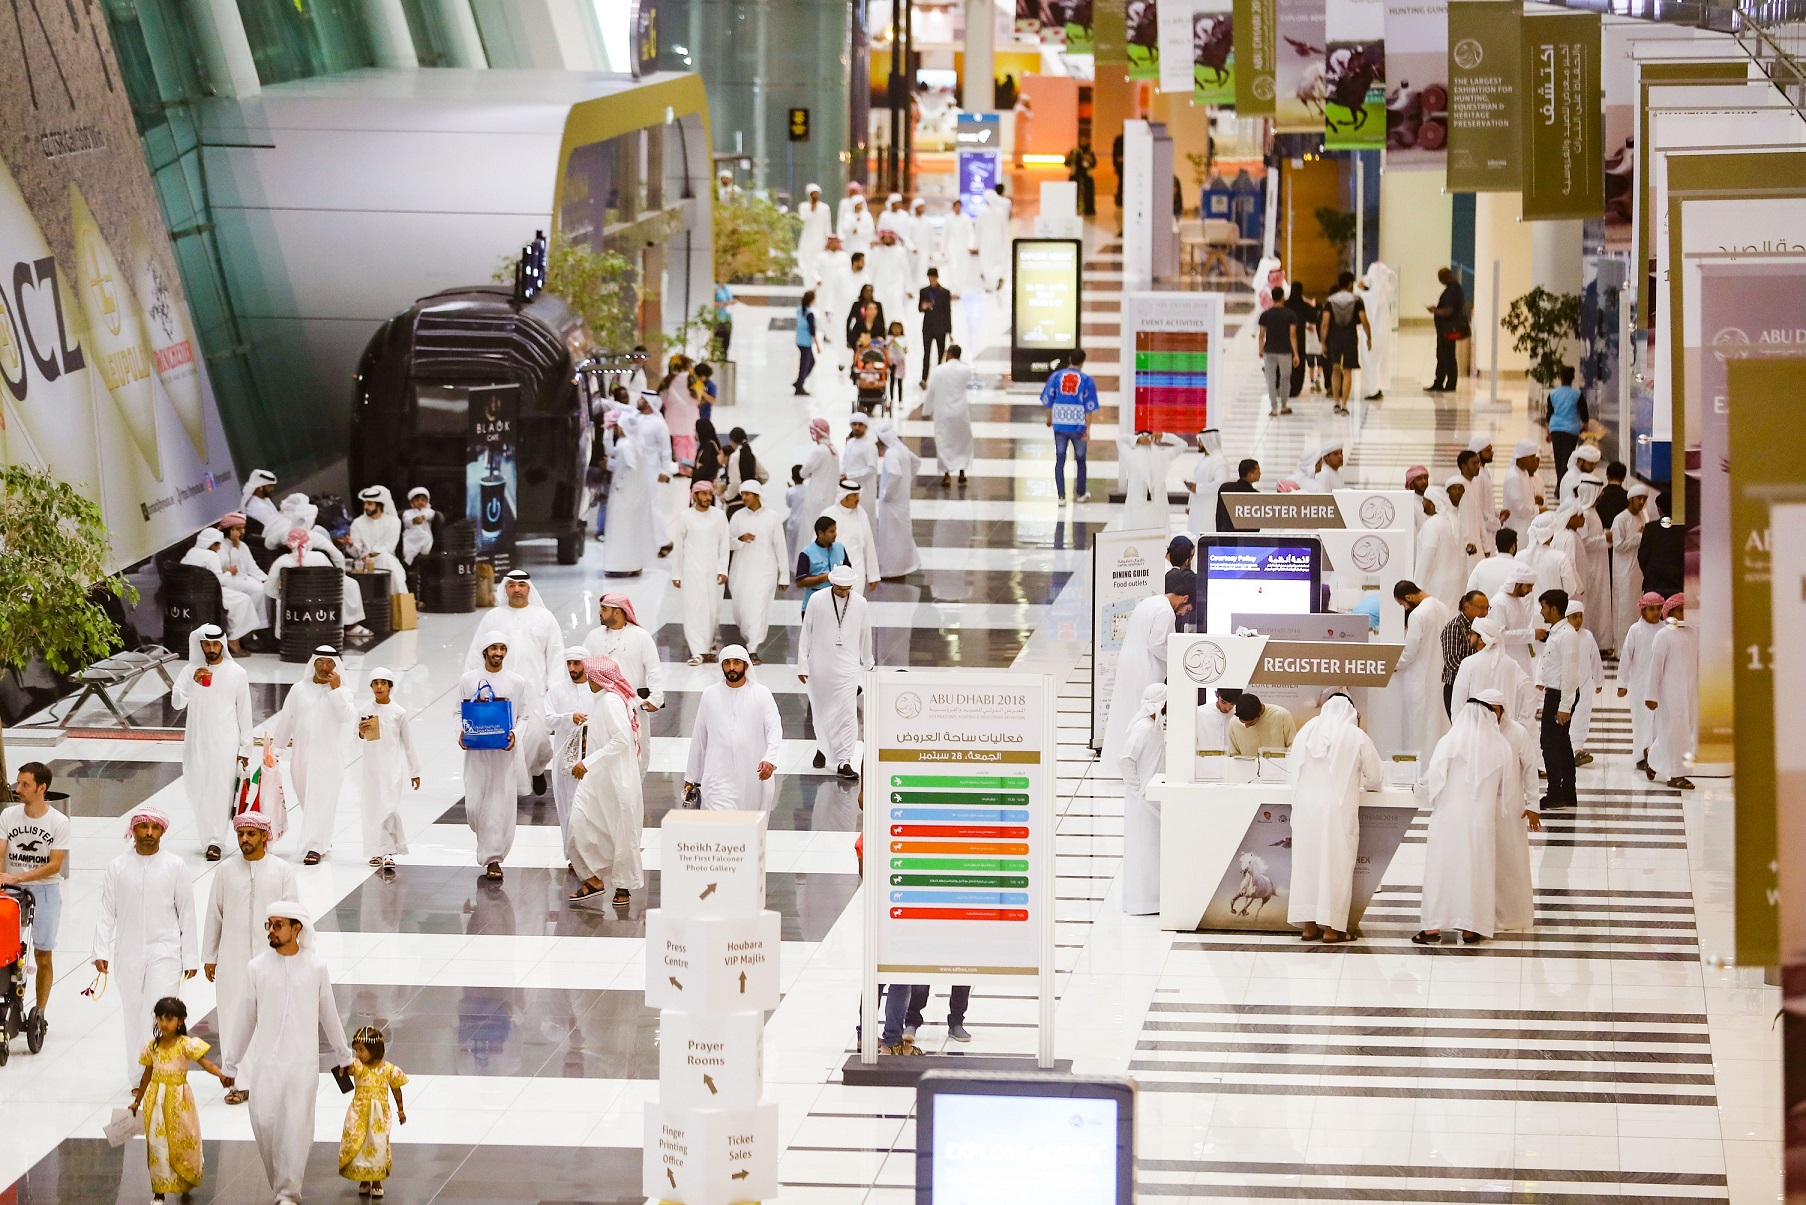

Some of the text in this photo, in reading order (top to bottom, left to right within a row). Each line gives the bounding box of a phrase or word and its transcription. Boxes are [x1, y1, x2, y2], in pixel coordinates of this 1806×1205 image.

[1454, 77, 1502, 85] THE LARGEST
[1537, 44, 1555, 126] اكتشف
[1454, 120, 1509, 128] PRESERVATION
[1759, 329, 1793, 344] ABU
[1235, 505, 1335, 518] REGISTER HERE
[1209, 554, 1257, 564] Courtesy Policy
[1112, 569, 1150, 579] DINING GUIDE
[1113, 580, 1127, 588] Food
[1263, 657, 1386, 675] REGISTER HERE
[929, 694, 1026, 706] ABU DHABI 2018
[896, 732, 1024, 745] فعاليات ساحة العروض
[918, 751, 949, 761] سبتمبر
[951, 752, 963, 760] 28
[7, 825, 54, 846] HOLLISTER
[676, 843, 746, 855] Sheikh Zayed
[710, 865, 737, 873] Gallery
[666, 940, 687, 953] Press
[727, 940, 763, 952] Houbara
[664, 956, 689, 968] Centre
[724, 953, 766, 966] VIP Majlis
[688, 1040, 725, 1053] Prayer
[687, 1055, 725, 1066] Rooms
[662, 1125, 685, 1139] Finger
[727, 1134, 754, 1146] Ticket
[659, 1138, 688, 1156] Printing
[662, 1154, 684, 1167] Office
[729, 1150, 752, 1161] Sales
